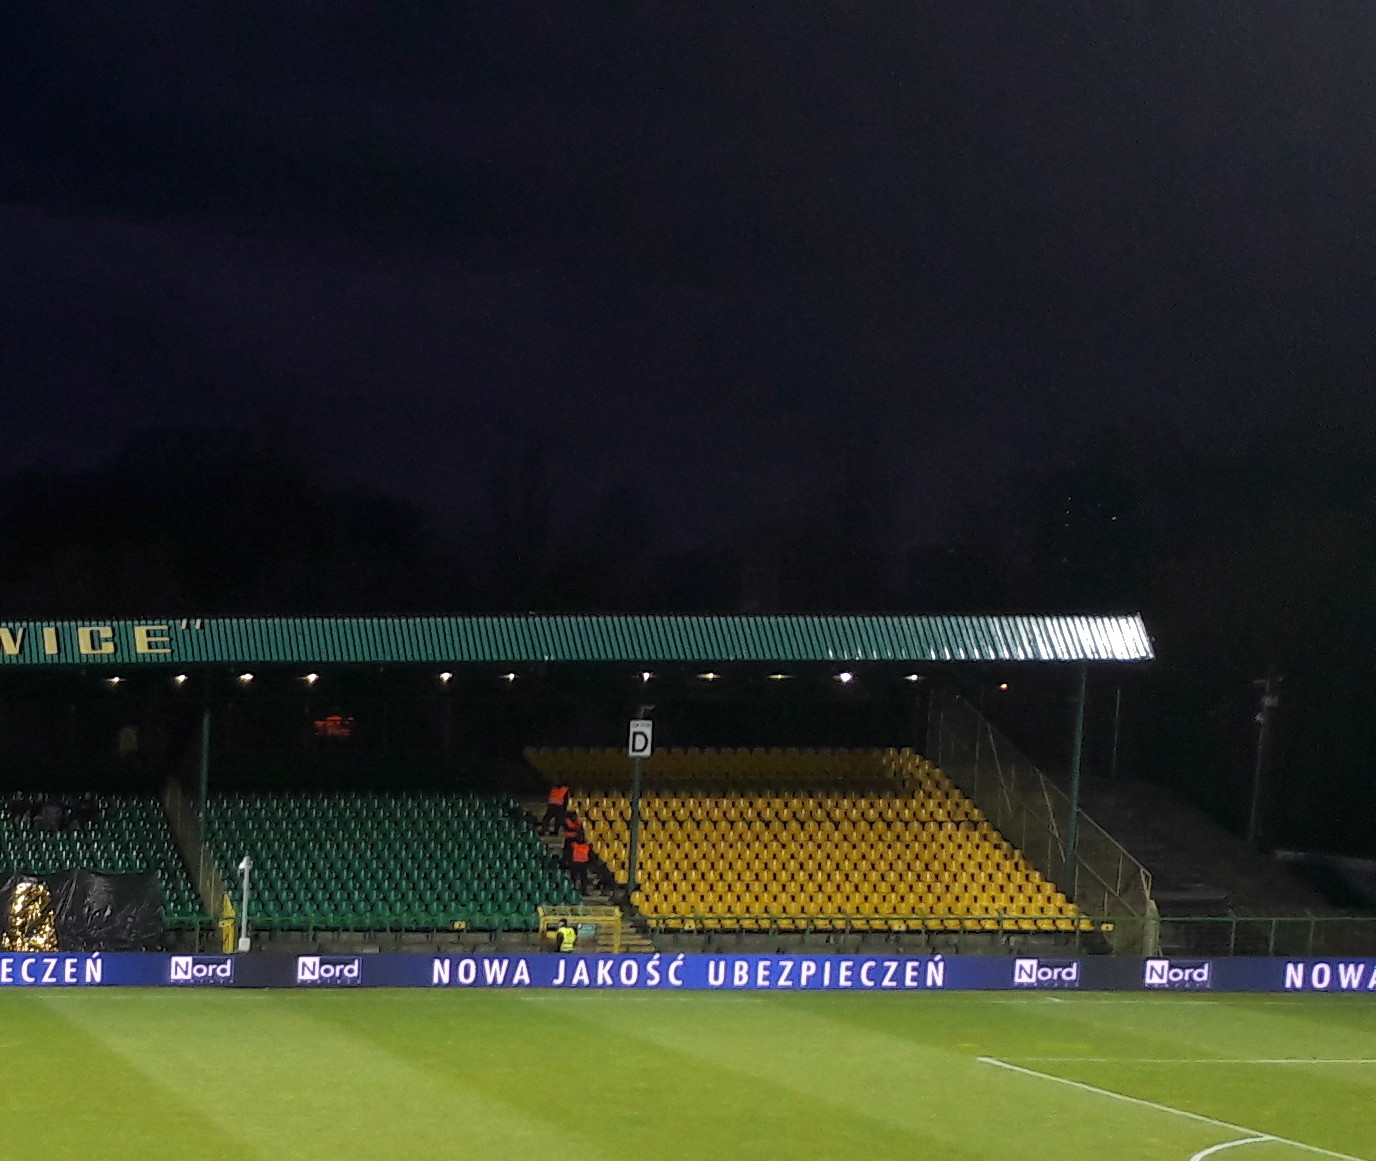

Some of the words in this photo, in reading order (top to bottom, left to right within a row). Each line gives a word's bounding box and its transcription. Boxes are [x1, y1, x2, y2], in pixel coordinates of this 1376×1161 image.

[632, 731, 649, 753] D
[170, 956, 232, 980] Nord
[297, 956, 359, 981] Nord
[432, 958, 531, 985] NOWA
[552, 953, 685, 986] JAKOŚĆ
[708, 954, 945, 987] UBEZPIECZEŃ
[1013, 958, 1077, 982] Nord
[1144, 959, 1209, 983] Nord
